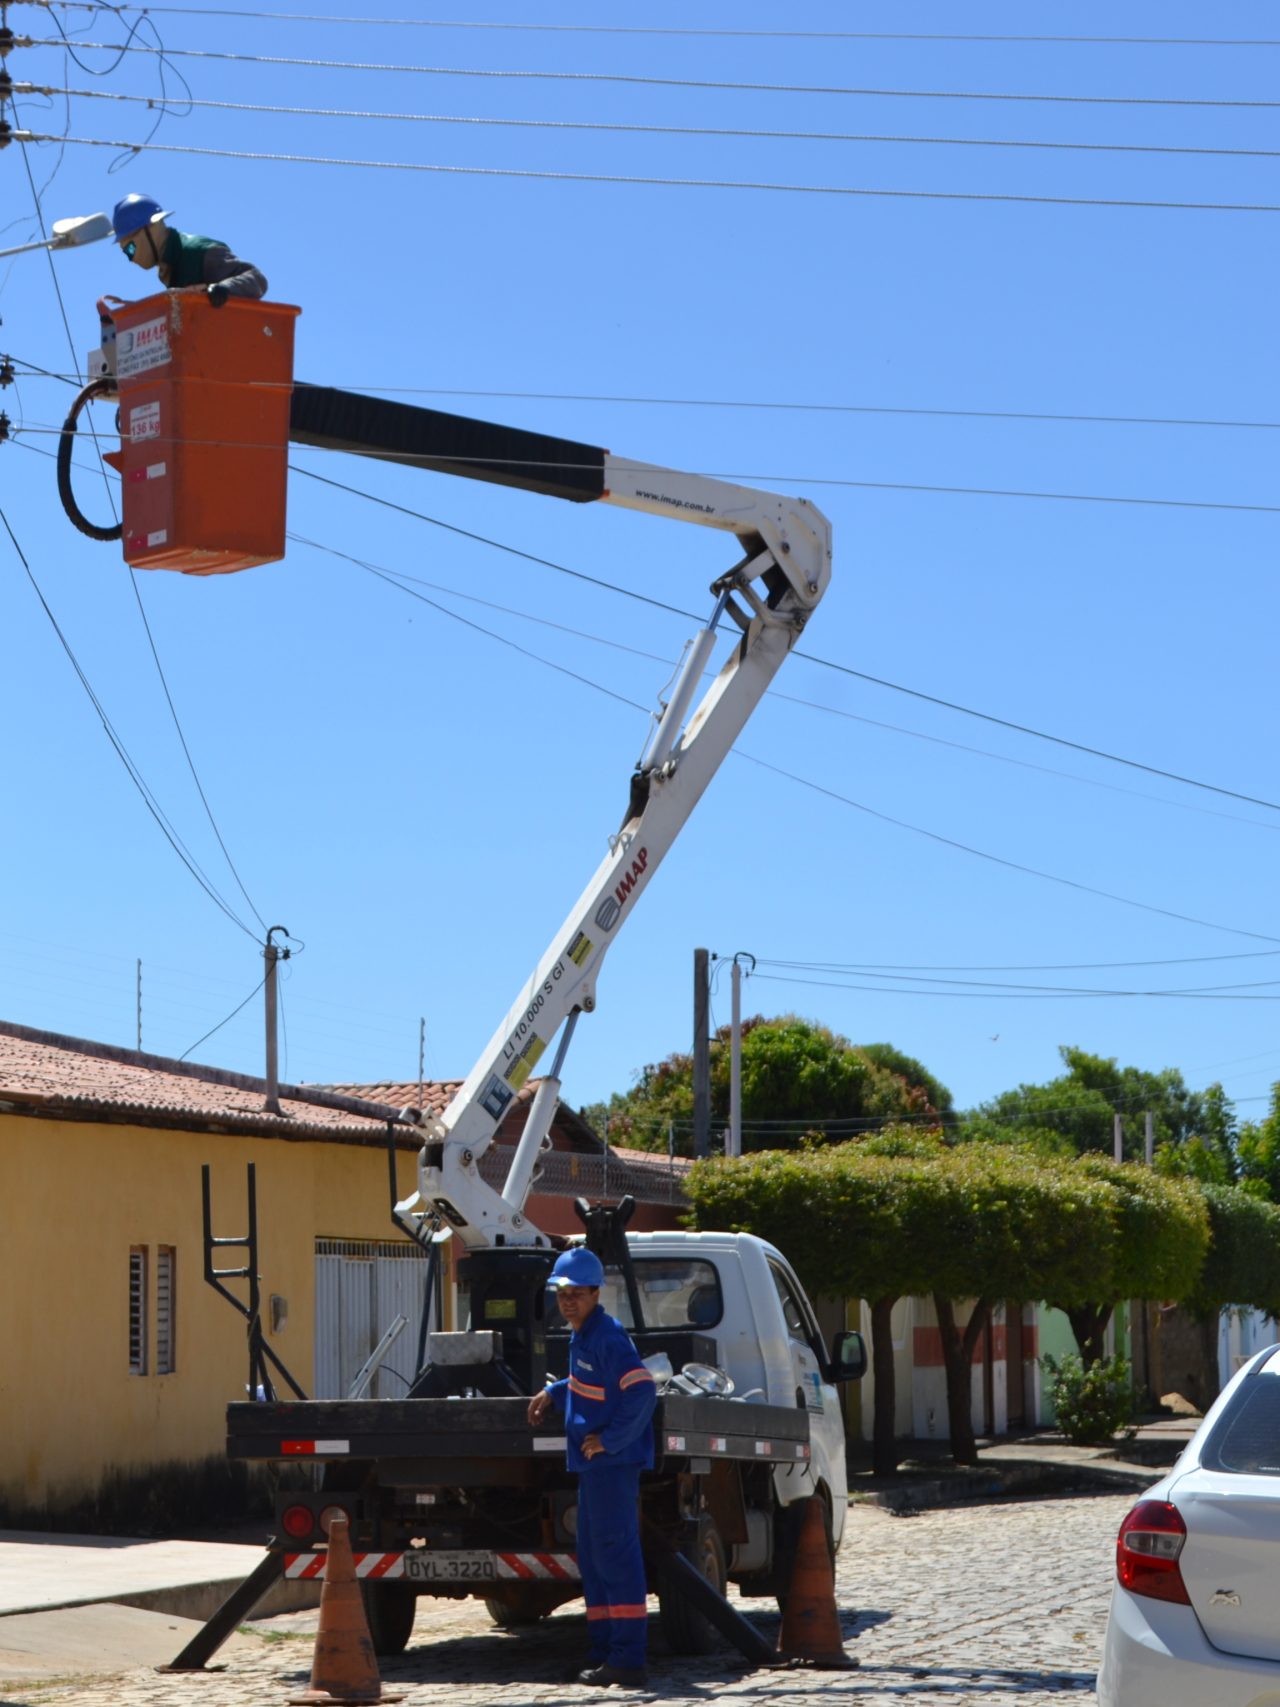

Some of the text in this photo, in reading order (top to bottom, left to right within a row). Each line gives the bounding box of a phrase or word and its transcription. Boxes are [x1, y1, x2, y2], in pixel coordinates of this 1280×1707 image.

[635, 489, 715, 513] www.imap.com.br
[615, 846, 648, 904] IMAP
[503, 1041, 515, 1060] LI
[515, 994, 545, 1041] 10.000
[544, 981, 553, 995] S
[552, 961, 566, 981] GI
